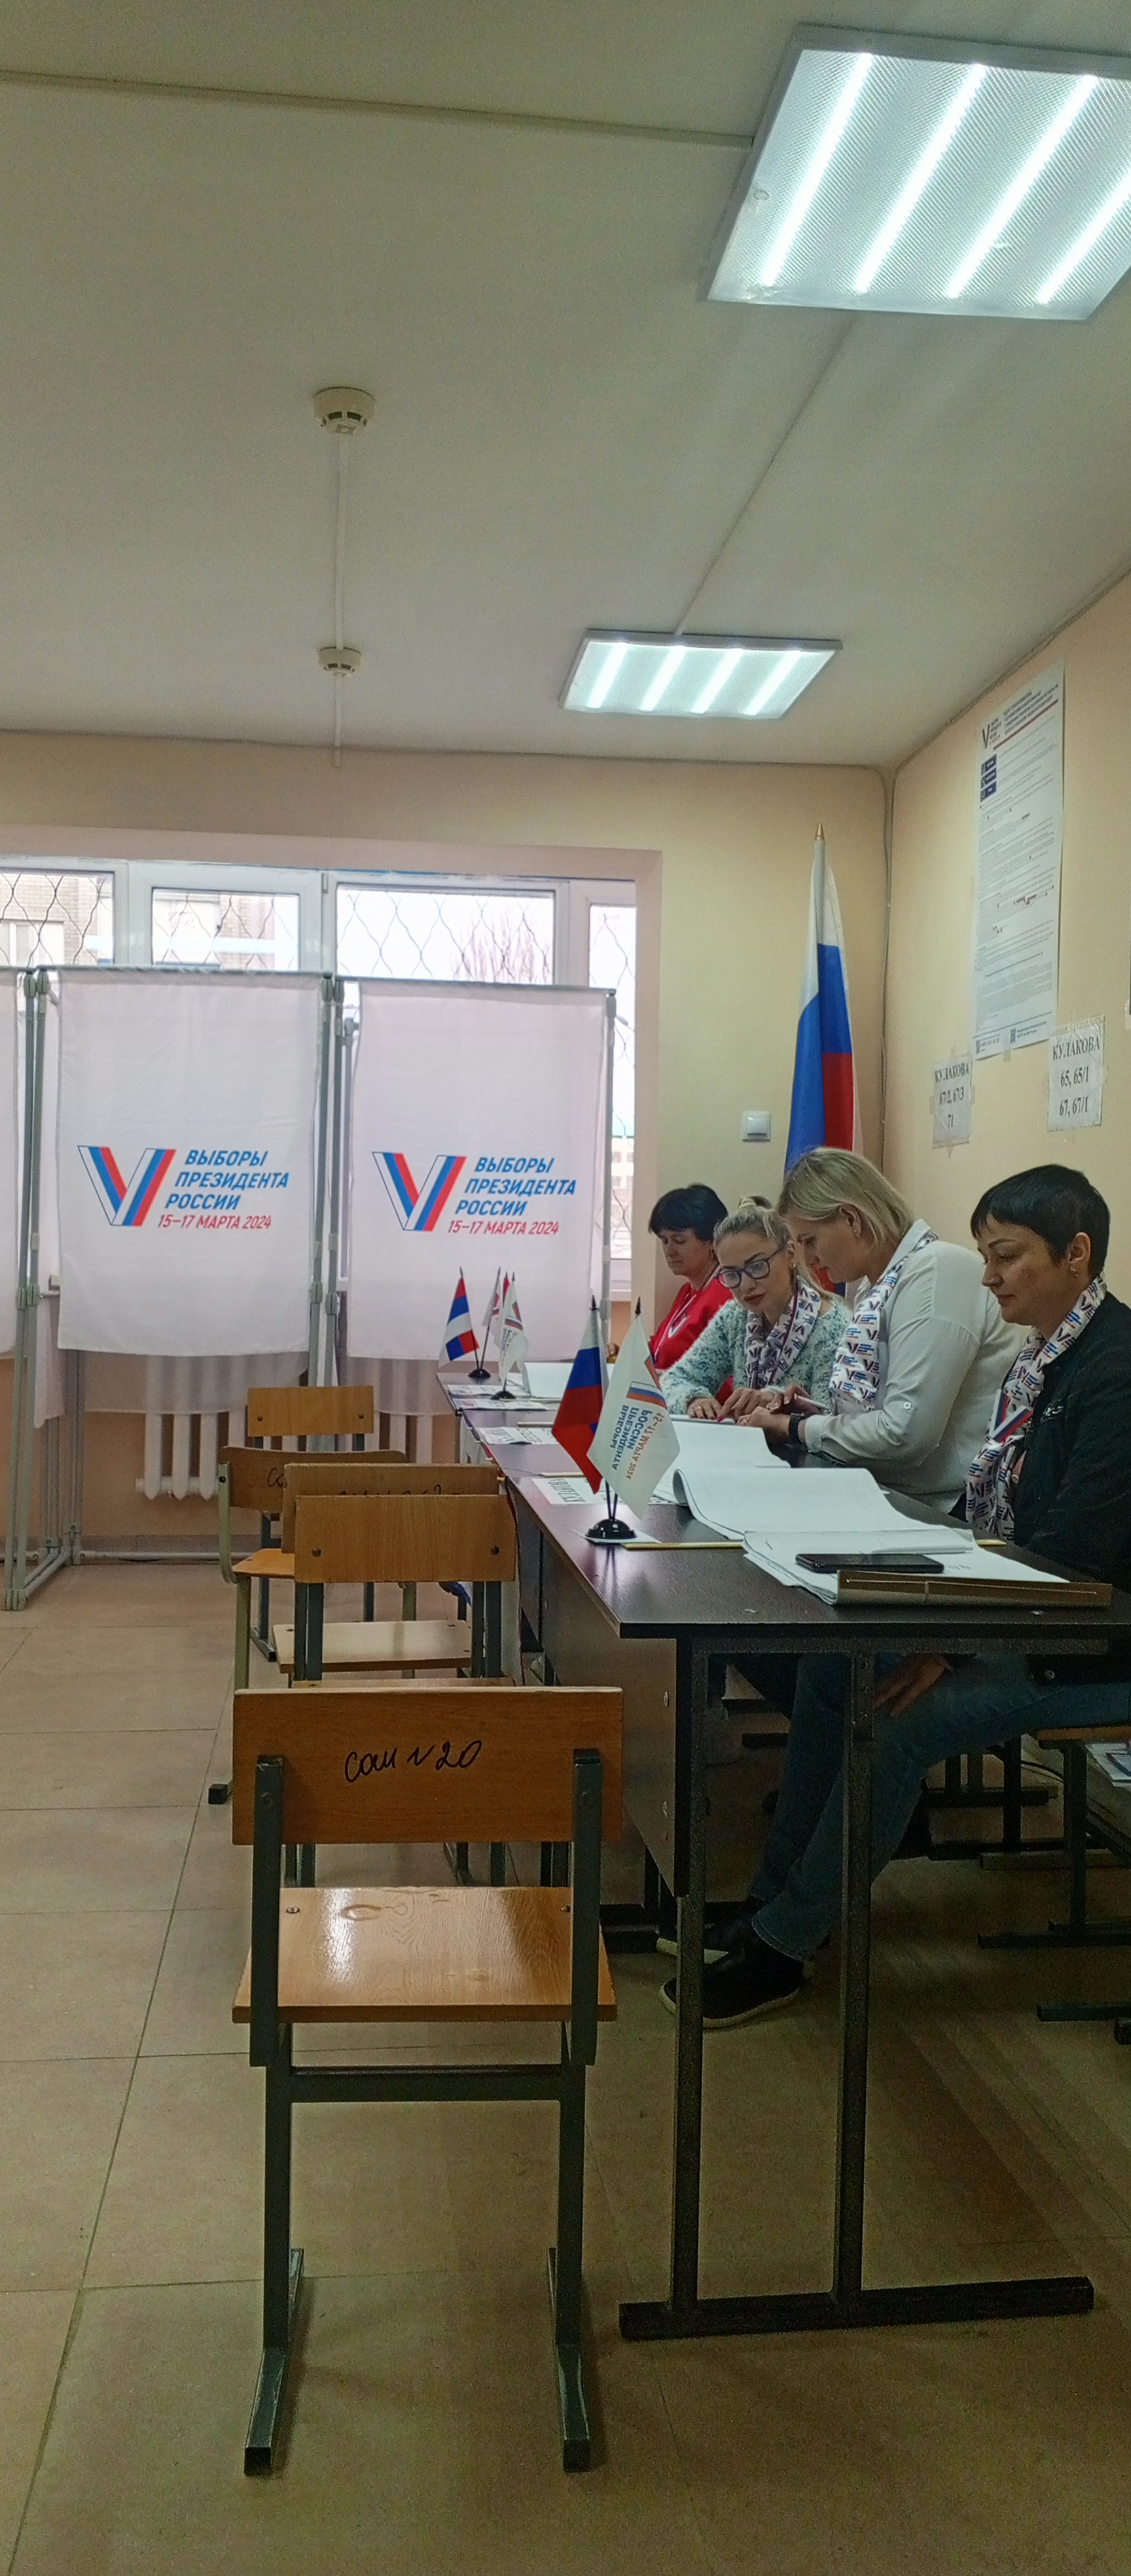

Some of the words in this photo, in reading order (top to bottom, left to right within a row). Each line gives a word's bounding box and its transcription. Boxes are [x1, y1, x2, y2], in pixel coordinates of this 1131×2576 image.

[1052, 1036, 1100, 1061] КУЛАКОВА
[935, 1062, 969, 1083] КУЛАКОВА
[1060, 1071, 1071, 1089] 65,
[1073, 1067, 1089, 1084] 65/1
[1059, 1100, 1071, 1117] 67,
[1072, 1096, 1088, 1113] 67/1
[185, 1150, 268, 1167] ВЫБОРЫ
[474, 1157, 554, 1173] ВЫБОРЫ
[174, 1172, 289, 1190] ПРЕЗИДЕНТА
[464, 1179, 576, 1196] ПРЕЗИДЕНТА
[164, 1194, 241, 1210] РОССИИ
[454, 1200, 528, 1216] РОССИИ
[196, 1215, 240, 1229] МАРТА
[242, 1215, 272, 1229] 2024
[484, 1221, 525, 1234] МАРТА
[528, 1221, 560, 1235] 2024
